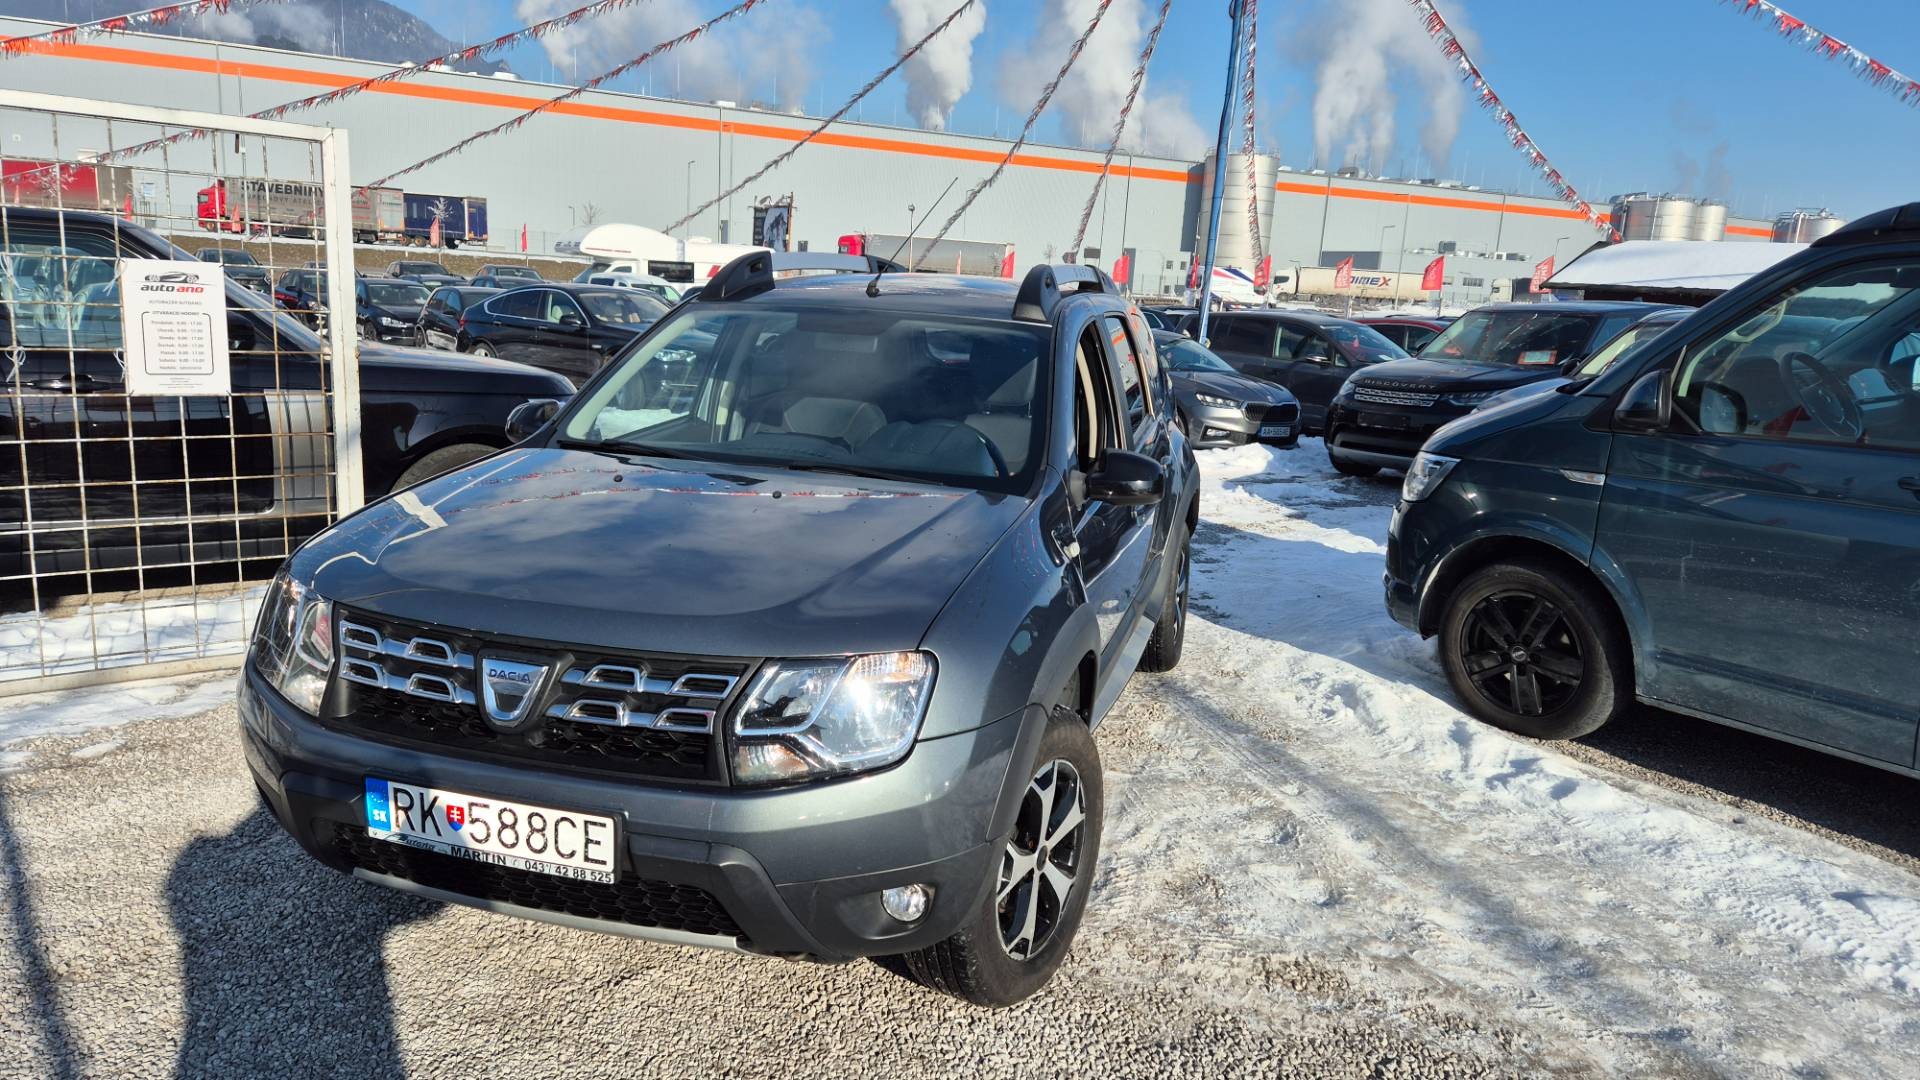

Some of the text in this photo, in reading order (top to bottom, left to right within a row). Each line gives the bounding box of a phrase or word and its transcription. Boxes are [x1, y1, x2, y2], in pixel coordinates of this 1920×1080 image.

[489, 668, 530, 683] DACIA
[372, 809, 387, 822] SK
[393, 787, 607, 866] RK 588CE
[451, 846, 507, 865] MARTIN
[555, 865, 569, 877] 42
[572, 868, 586, 879] 88
[590, 870, 612, 883] 525
